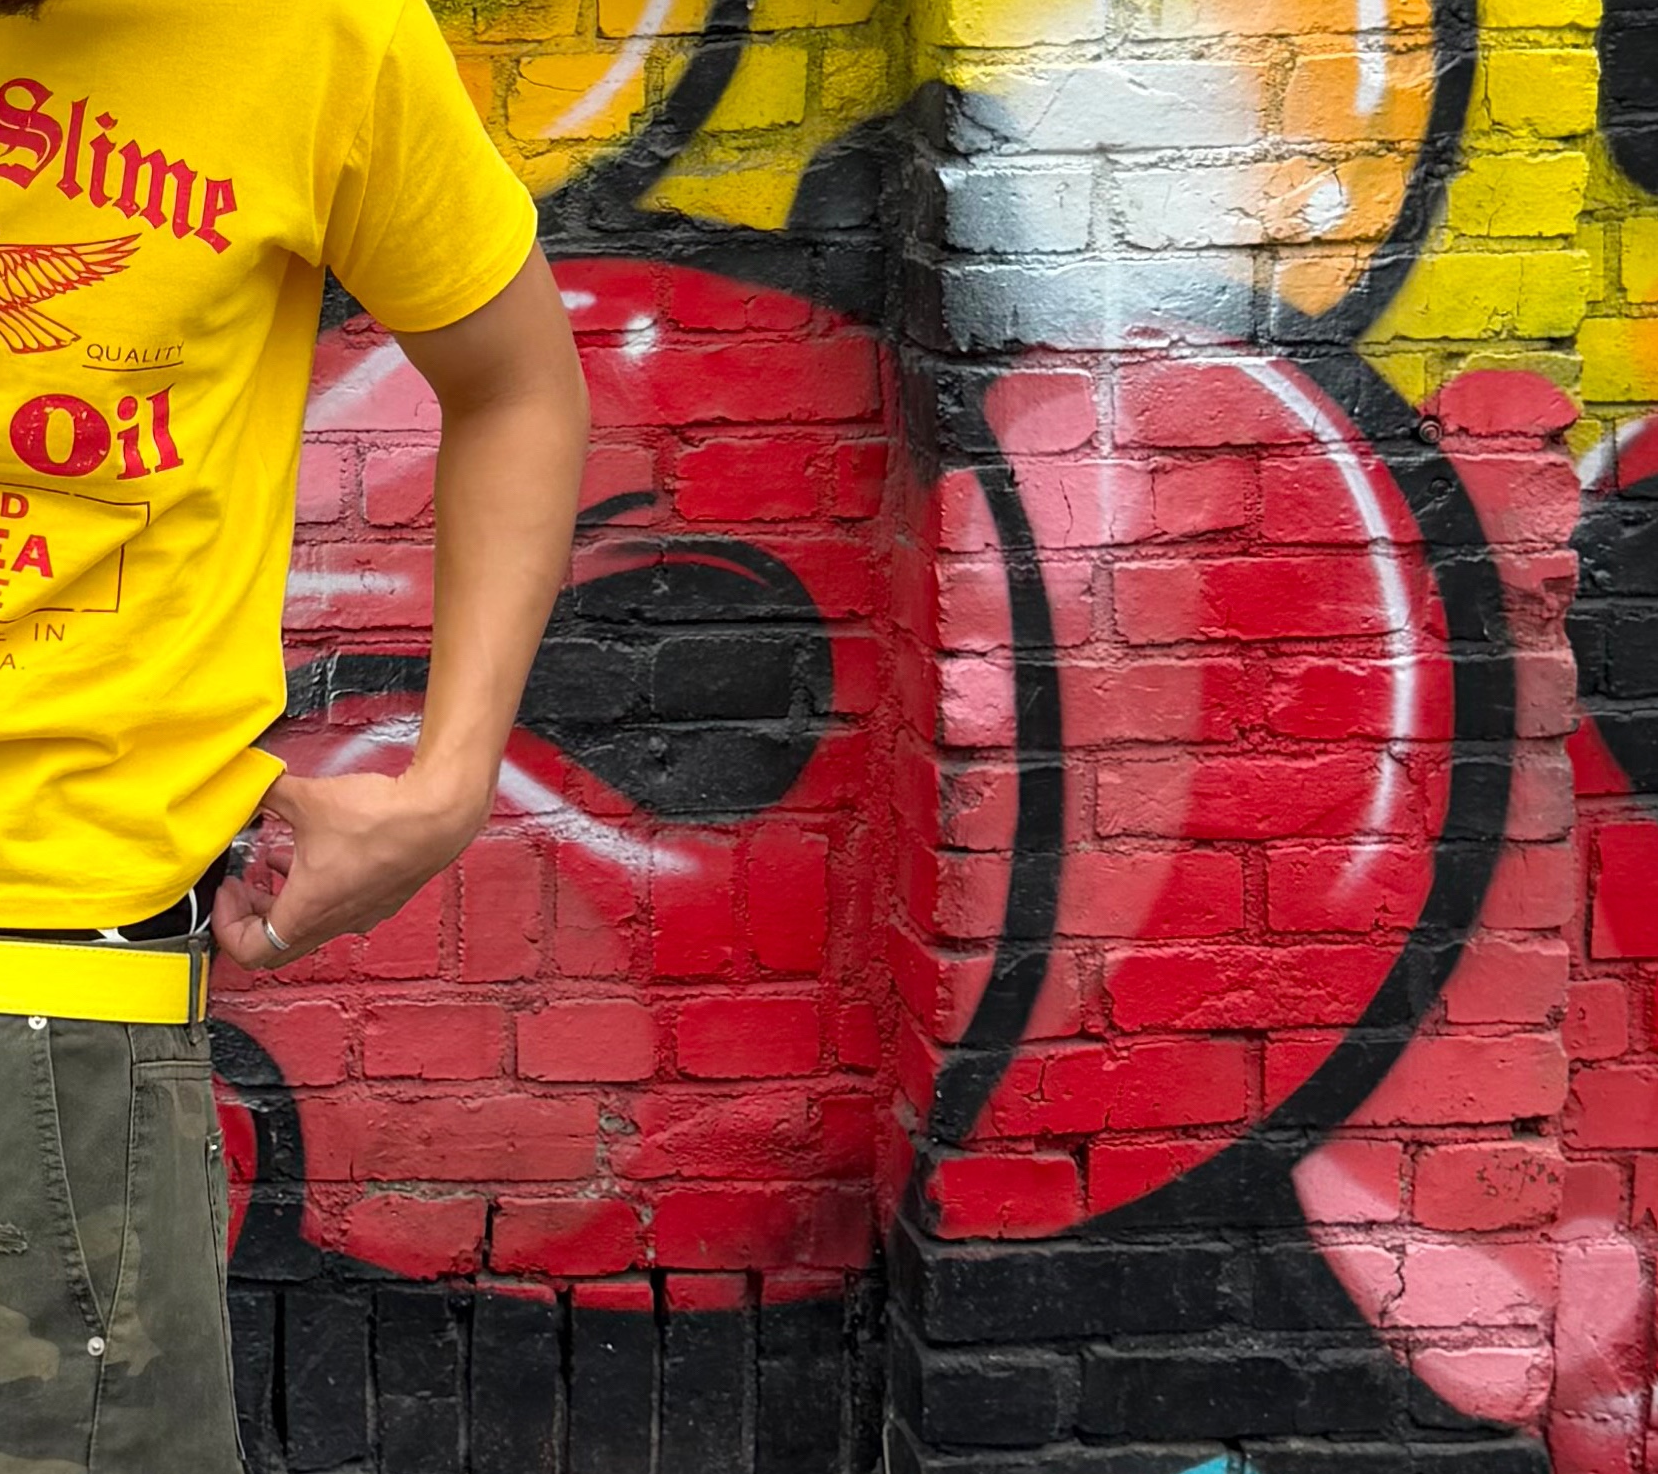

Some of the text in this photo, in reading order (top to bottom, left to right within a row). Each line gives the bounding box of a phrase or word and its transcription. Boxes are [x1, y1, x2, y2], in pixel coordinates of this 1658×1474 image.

[86, 341, 185, 365] QUALITY
[10, 384, 184, 480] Oil
[34, 622, 66, 642] IN
